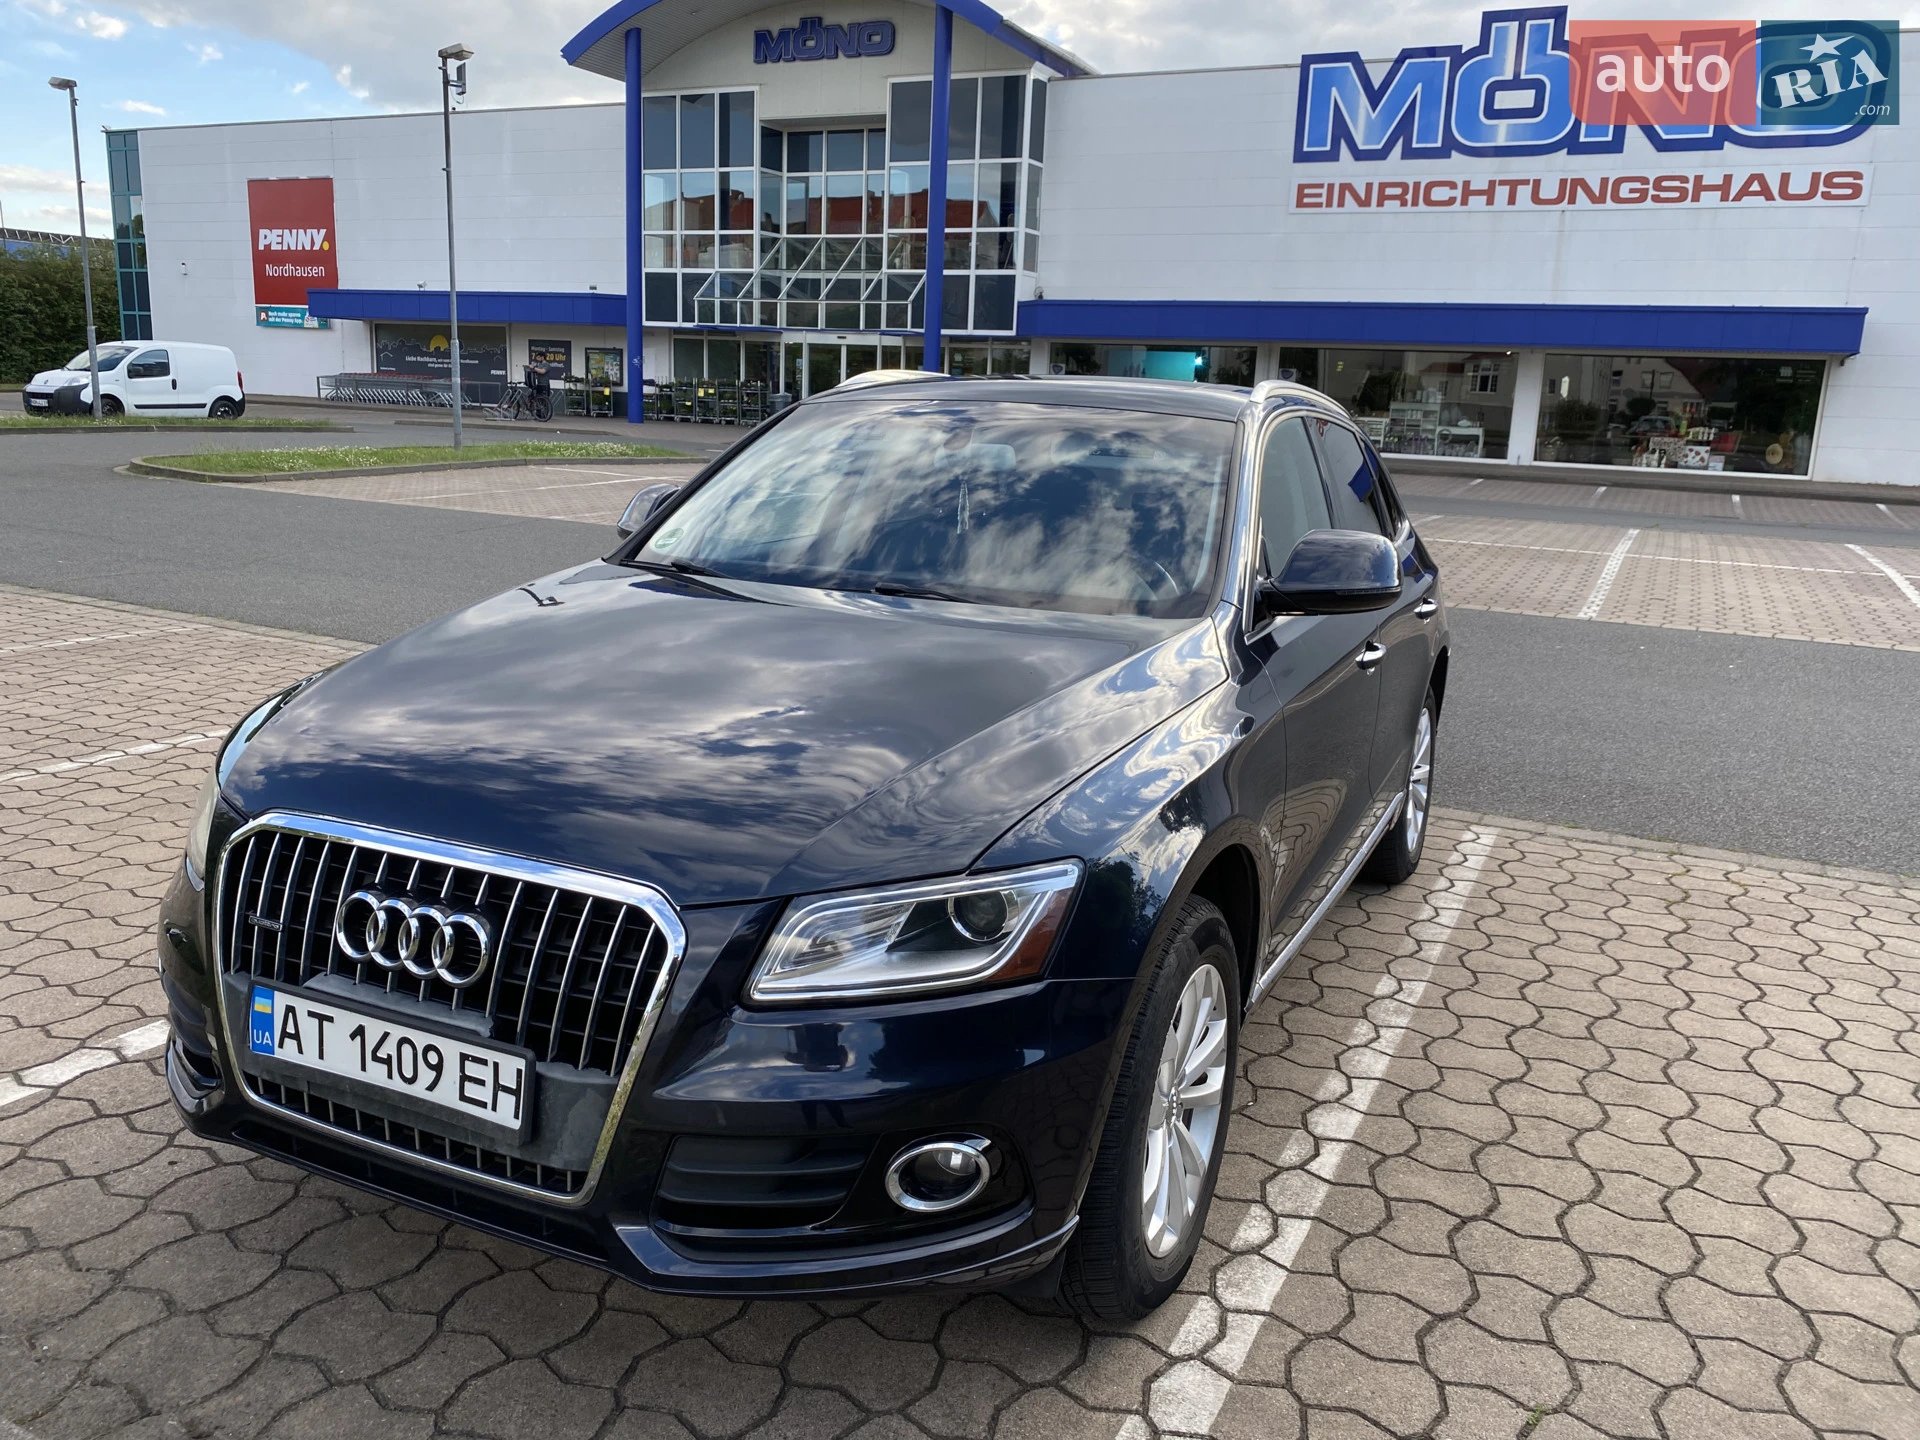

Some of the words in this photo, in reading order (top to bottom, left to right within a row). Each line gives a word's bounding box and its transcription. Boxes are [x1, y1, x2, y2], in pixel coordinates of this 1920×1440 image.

[754, 16, 896, 64] MÖNO
[1295, 170, 1865, 209] EINRICHTUNGSHAUS
[265, 263, 326, 278] Nordhausen
[555, 353, 567, 361] Uhr
[253, 1029, 272, 1047] UA
[277, 1004, 335, 1060] AT
[349, 1023, 444, 1092] 1409
[459, 1051, 523, 1120] EH
